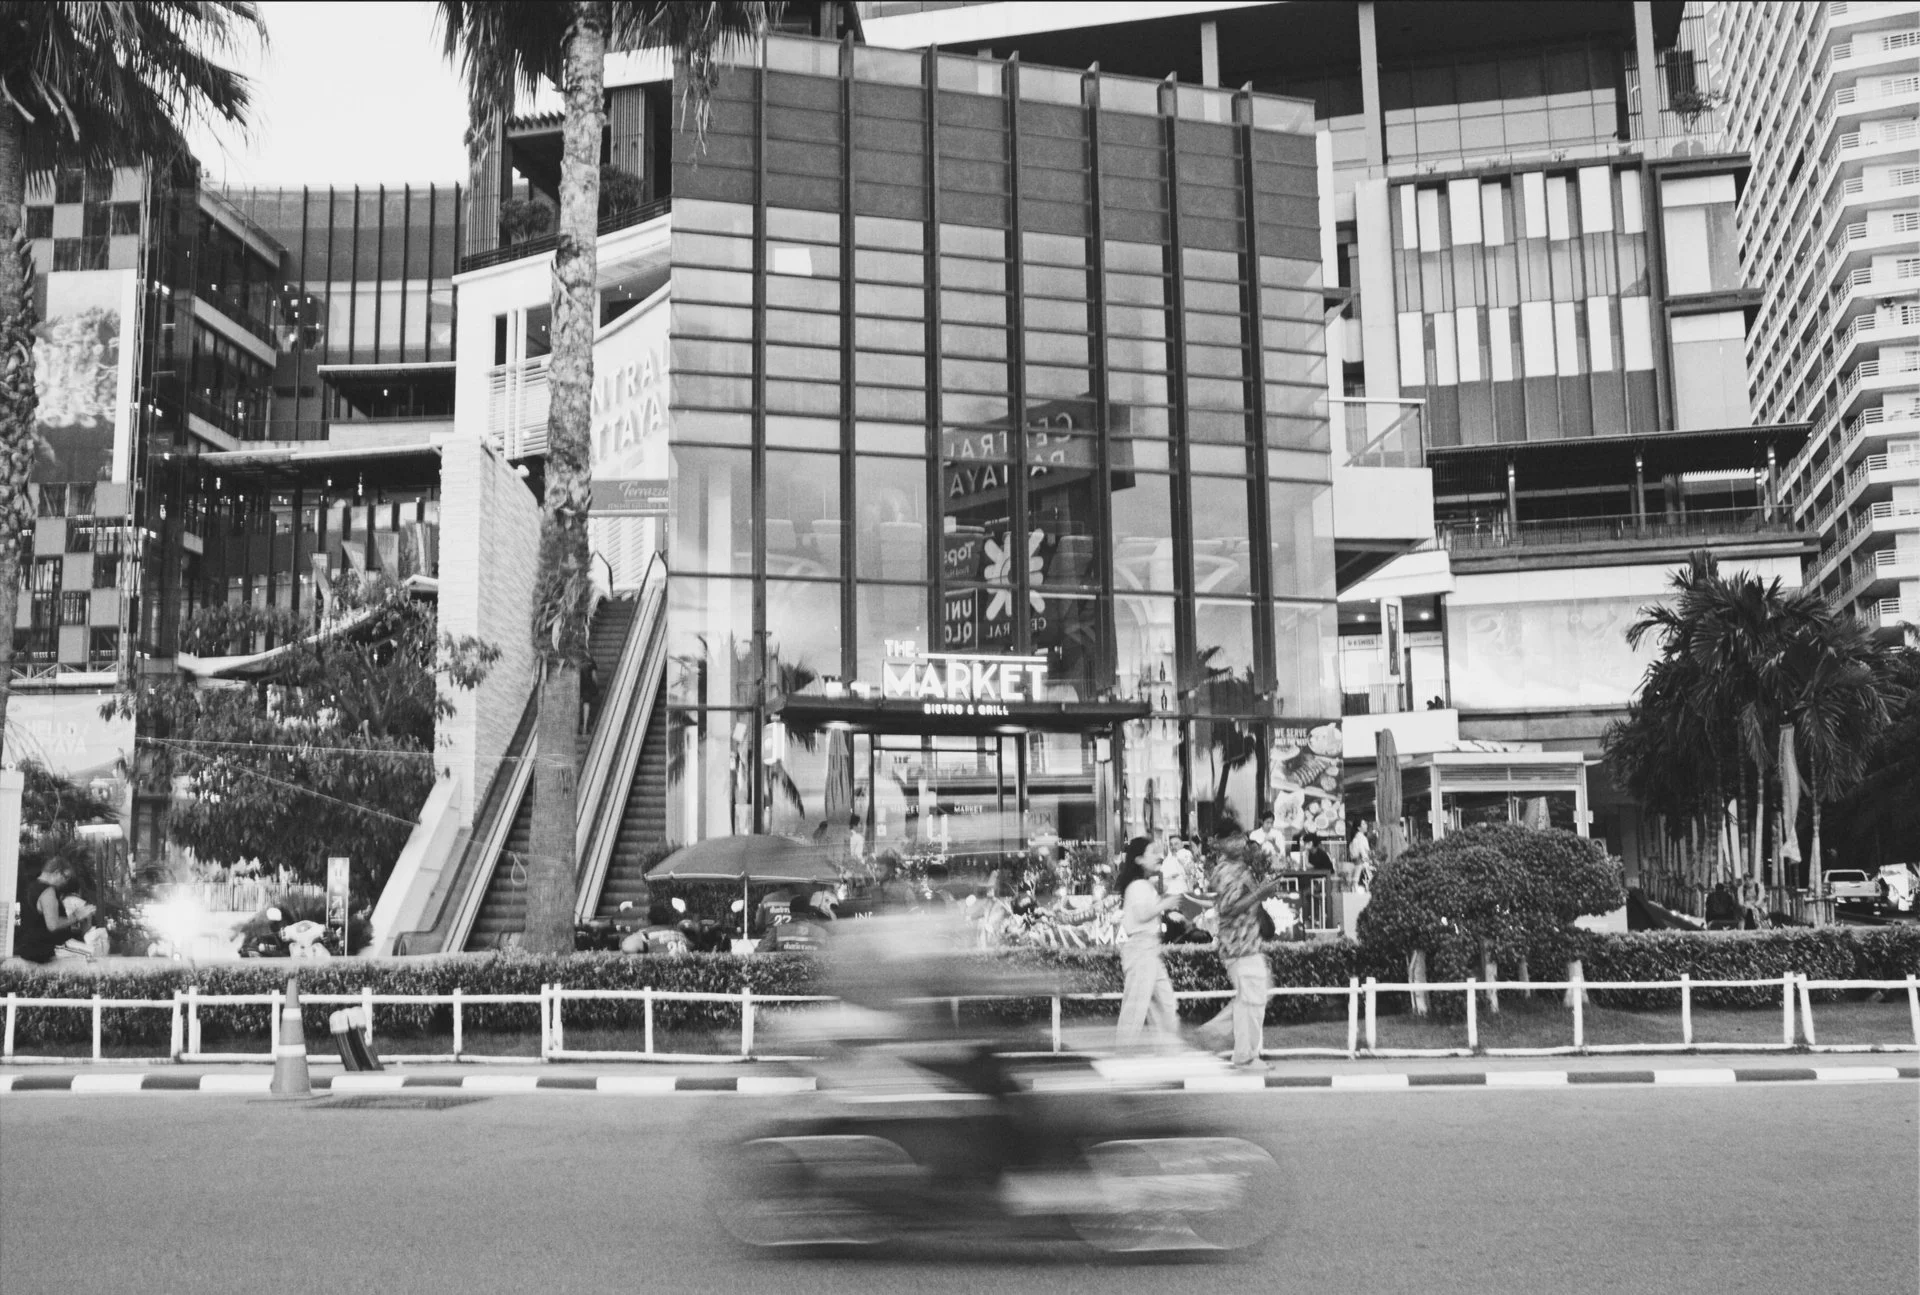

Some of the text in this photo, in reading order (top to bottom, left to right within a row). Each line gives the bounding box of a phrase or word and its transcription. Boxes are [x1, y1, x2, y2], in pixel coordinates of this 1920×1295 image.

[591, 338, 669, 416] NTRAL
[596, 391, 664, 461] TTAYA
[884, 639, 916, 657] THE
[883, 662, 1048, 701] MARKET
[923, 703, 1009, 716] BISTRO & GRILL
[1274, 728, 1308, 738] WE SERVE
[954, 804, 982, 814] MARKET
